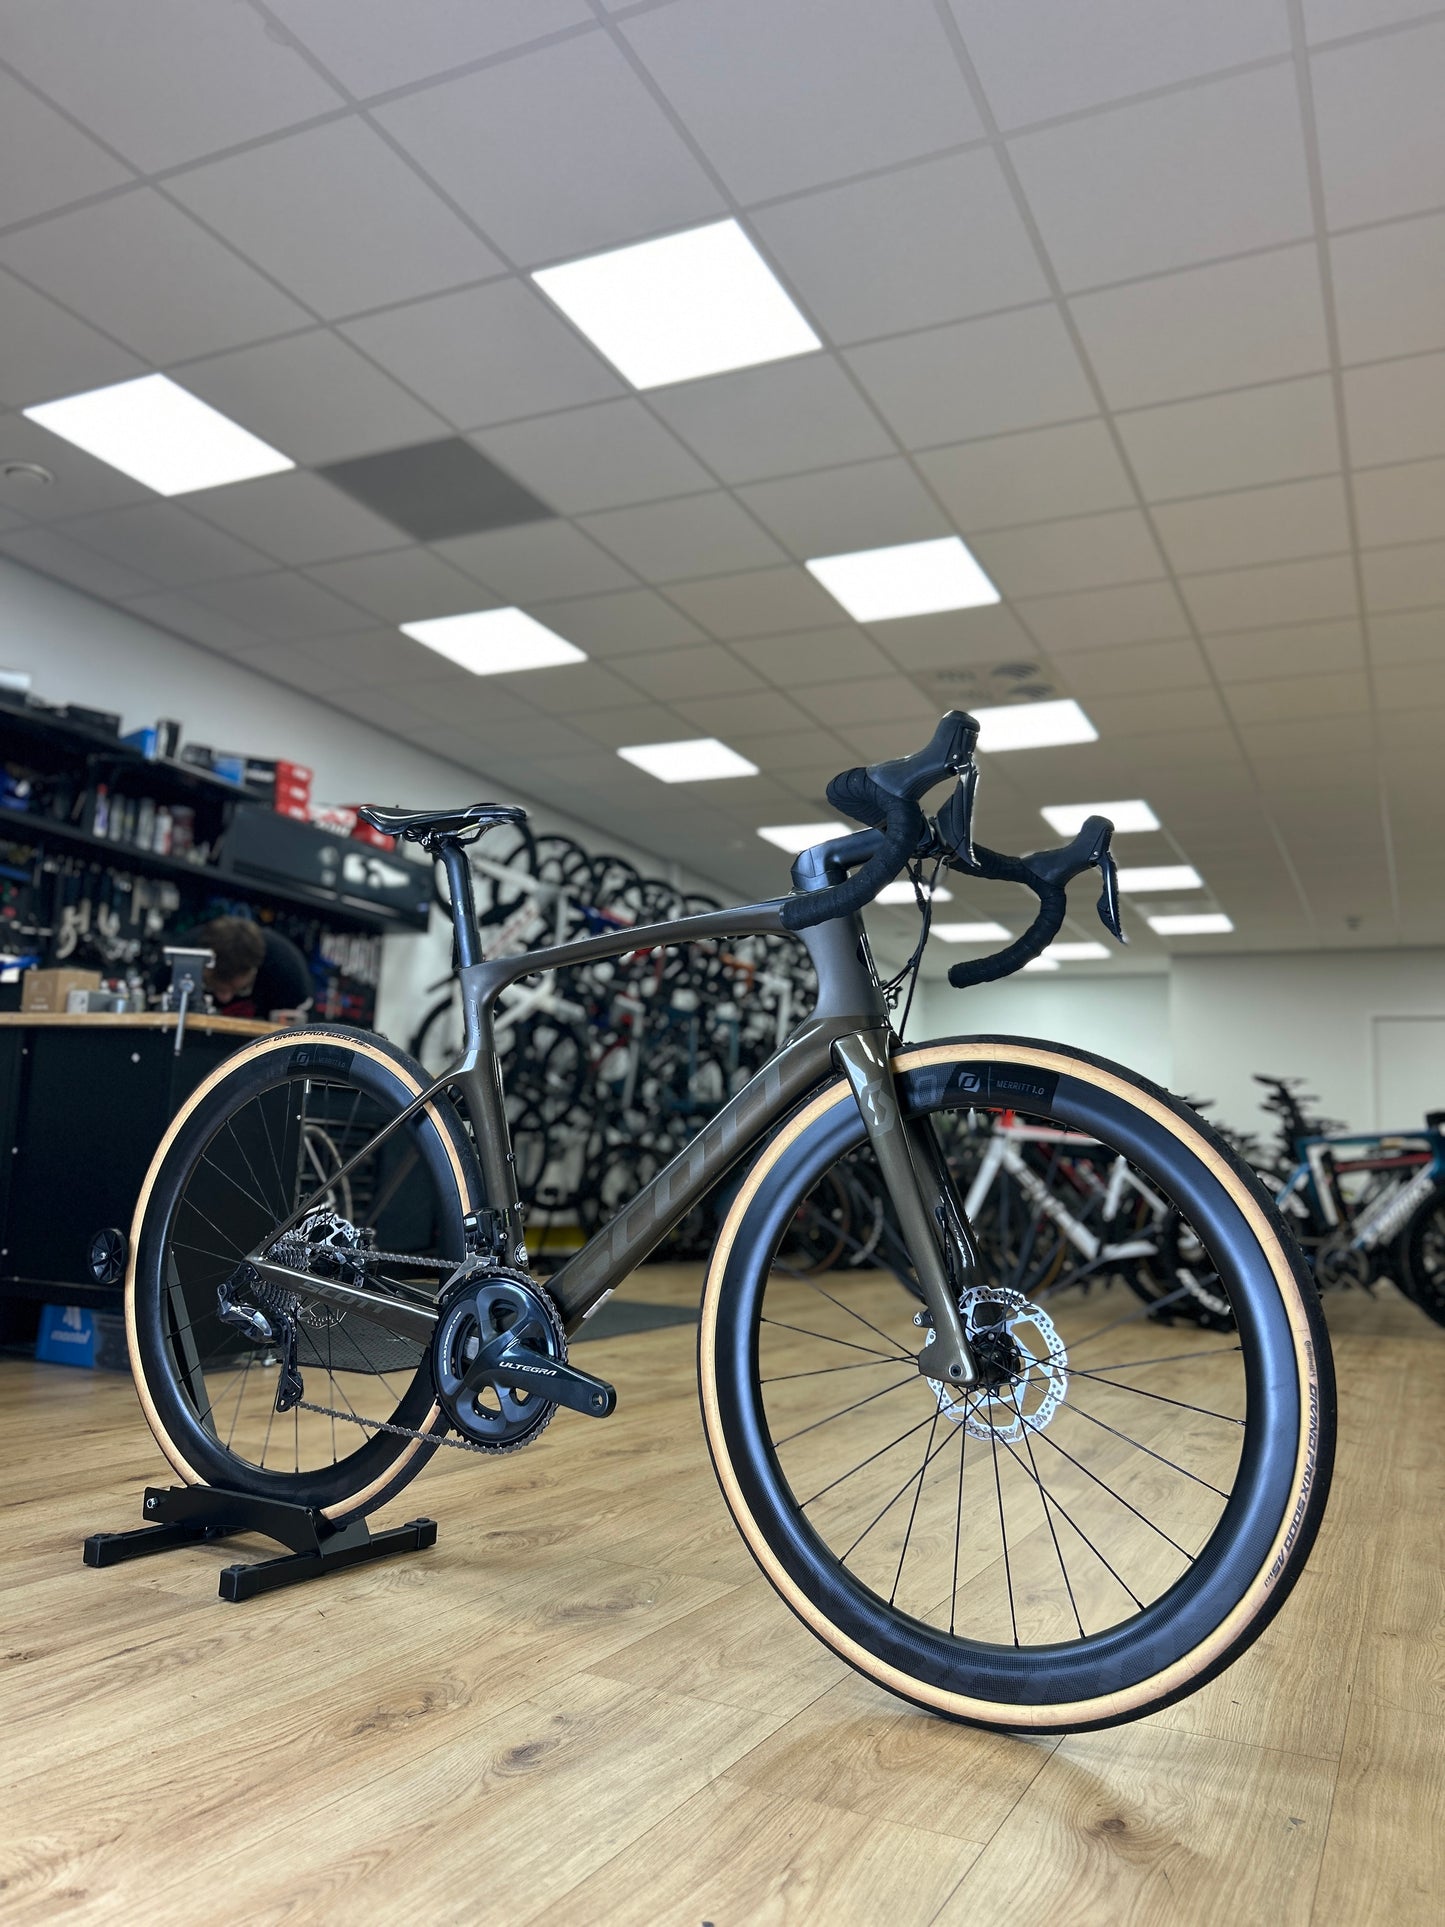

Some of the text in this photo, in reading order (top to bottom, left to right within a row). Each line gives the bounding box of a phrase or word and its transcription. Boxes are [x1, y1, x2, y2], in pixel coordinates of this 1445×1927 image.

[273, 1031, 304, 1041] GRAND
[325, 1032, 352, 1041] 5000
[995, 1080, 1045, 1096] MERRITT 1.0
[561, 1058, 782, 1296] SCOTT
[299, 1281, 391, 1314] SCOTT
[499, 1361, 558, 1377] ULTEGRA
[1308, 1382, 1318, 1450] GRAND
[1300, 1450, 1315, 1499] PRIX
[1283, 1496, 1306, 1552] 5000
